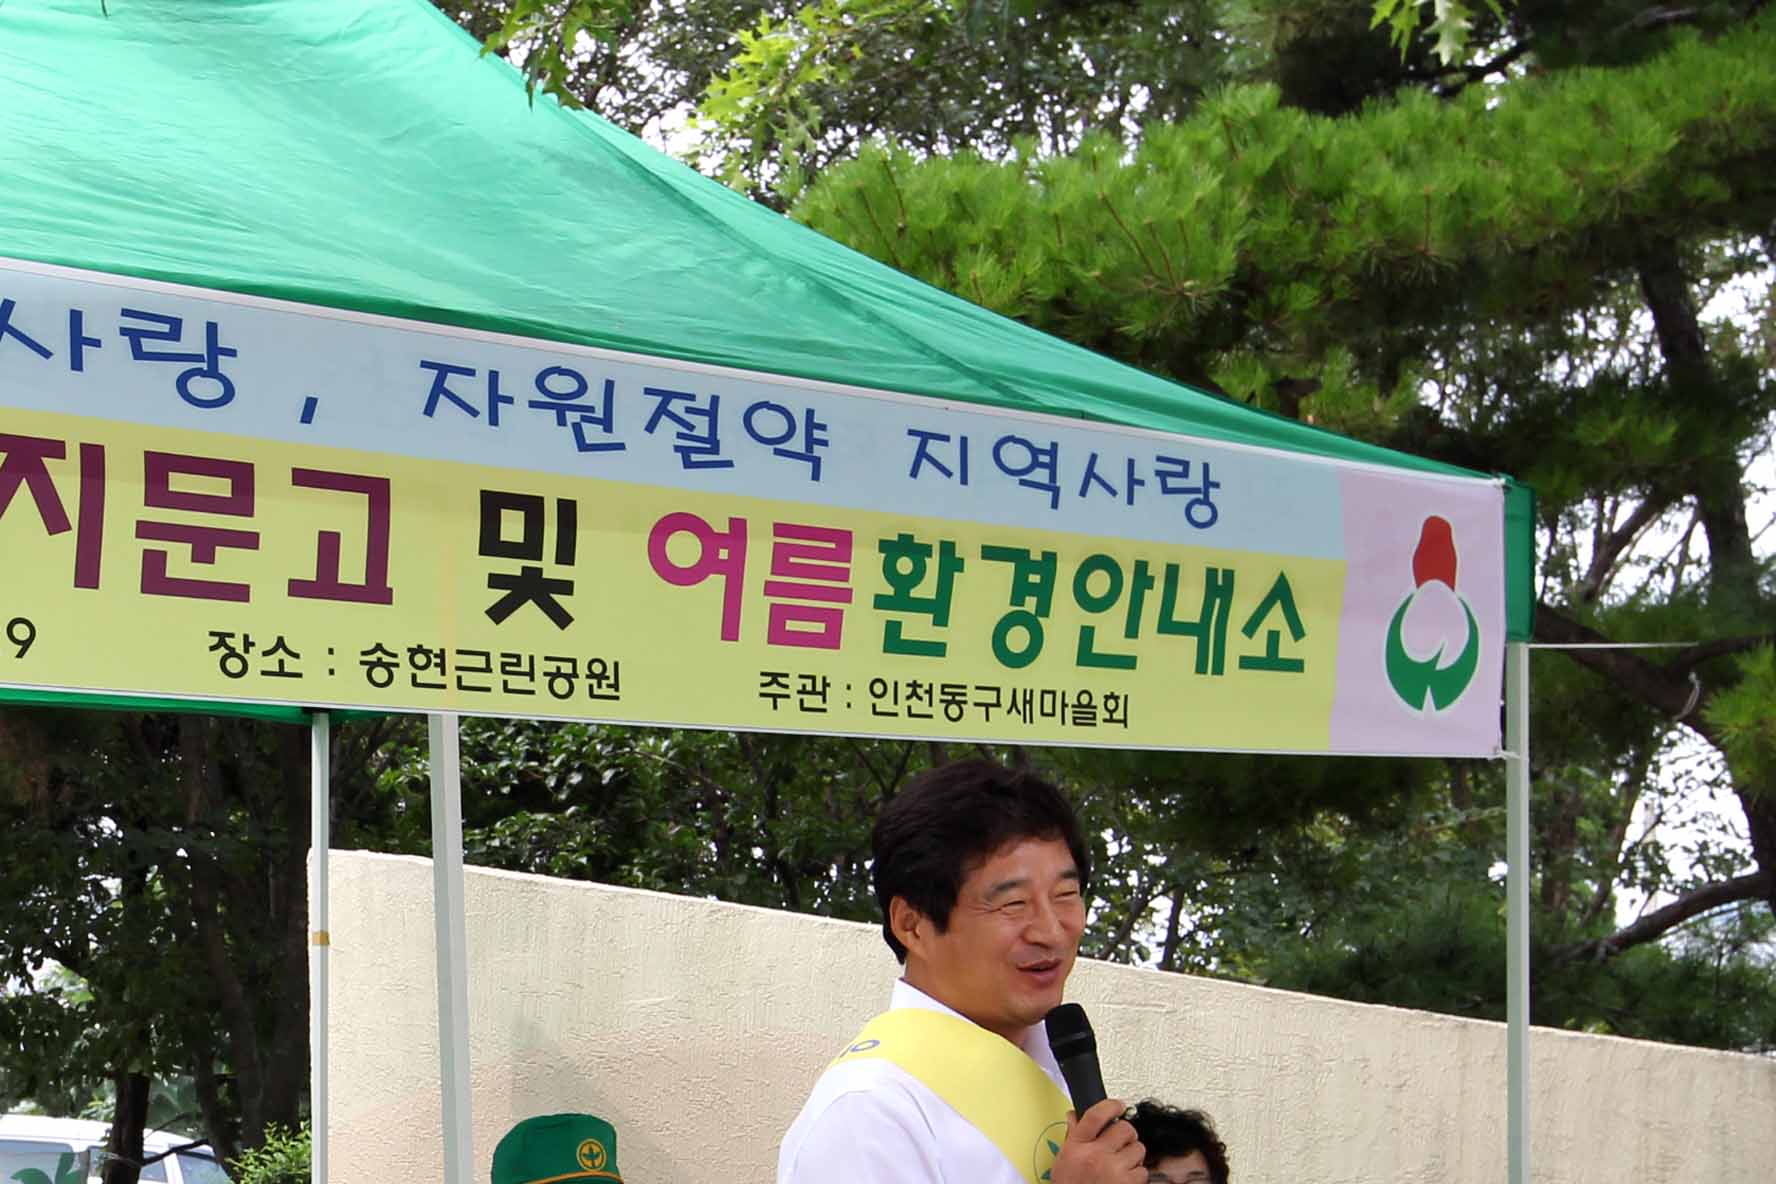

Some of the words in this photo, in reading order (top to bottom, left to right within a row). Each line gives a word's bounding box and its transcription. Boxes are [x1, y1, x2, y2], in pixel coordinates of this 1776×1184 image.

[419, 360, 830, 482] 자원절약
[906, 429, 1221, 529] 지역사랑
[477, 489, 578, 630] 및
[358, 642, 621, 702] 송현근린공원
[868, 675, 1130, 729] 인천동구새마을회
